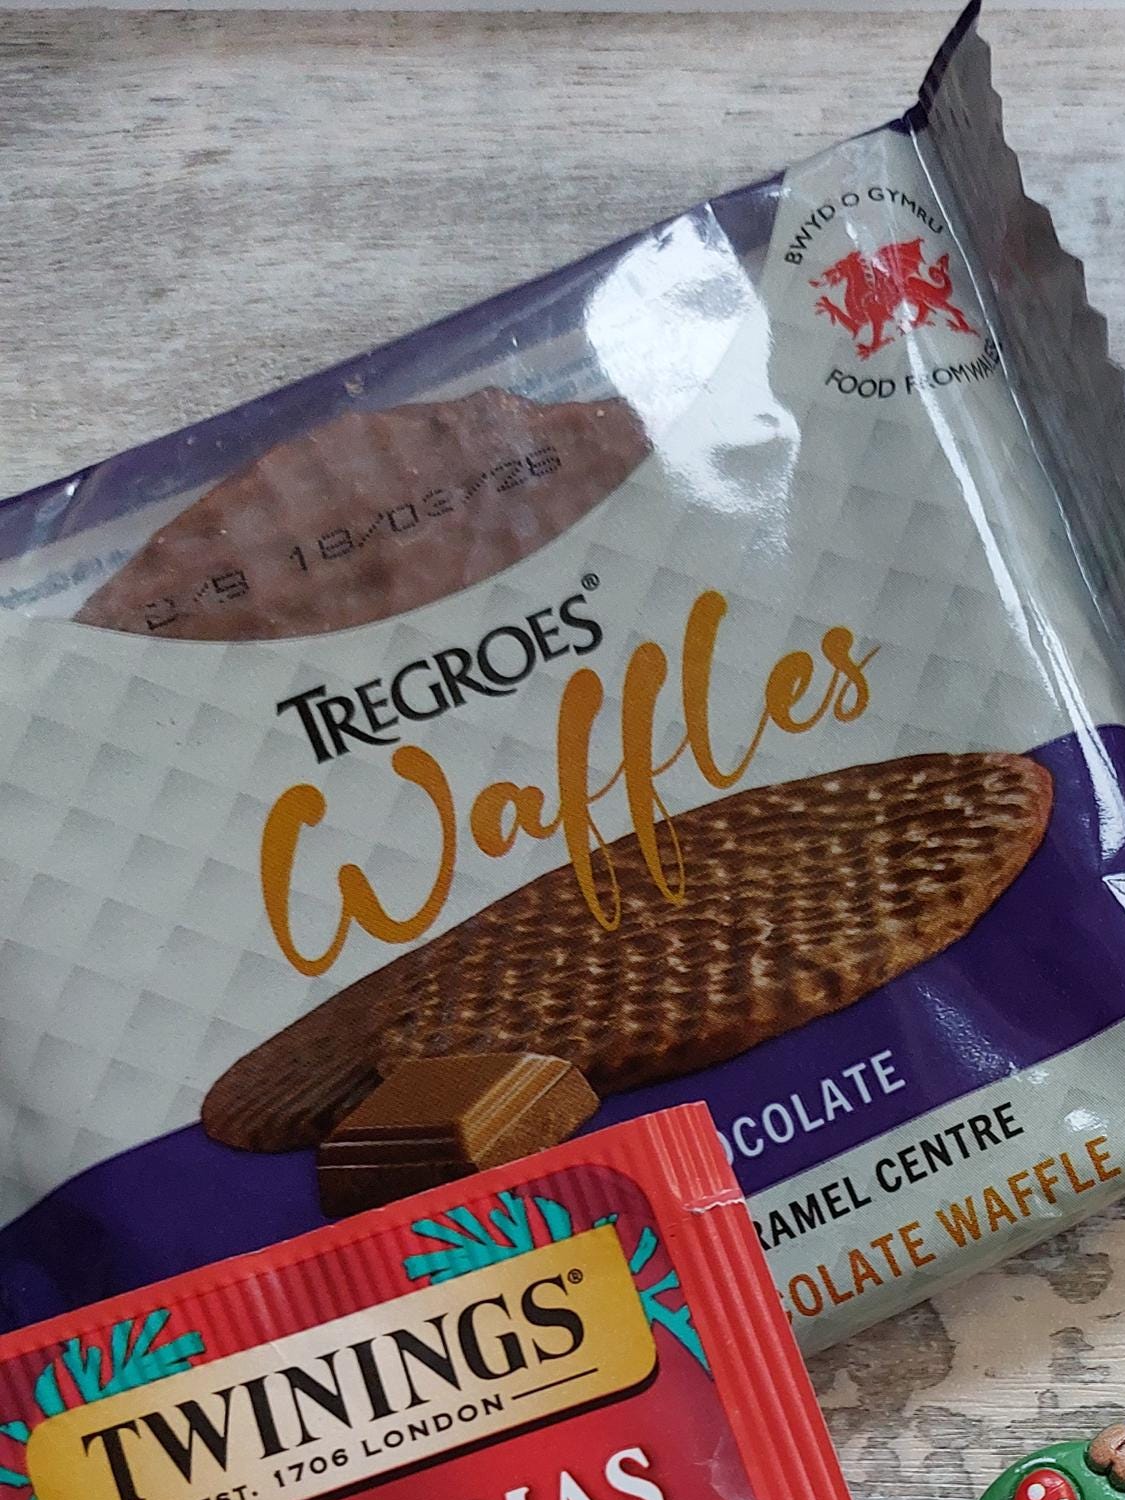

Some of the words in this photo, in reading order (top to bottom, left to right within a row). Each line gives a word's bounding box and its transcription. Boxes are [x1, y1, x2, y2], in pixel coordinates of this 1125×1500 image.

[784, 204, 836, 266] BWYD
[841, 193, 860, 208] O
[867, 187, 944, 235] GYMRU
[824, 368, 896, 398] FOOD
[261, 589, 880, 978] Waffles
[875, 1101, 1025, 1193] CENTRE
[778, 1220, 937, 1325] OLATE
[935, 1135, 1122, 1250] WAFFLE
[273, 1448, 349, 1488] 1706
[363, 1394, 505, 1458] LONDON
